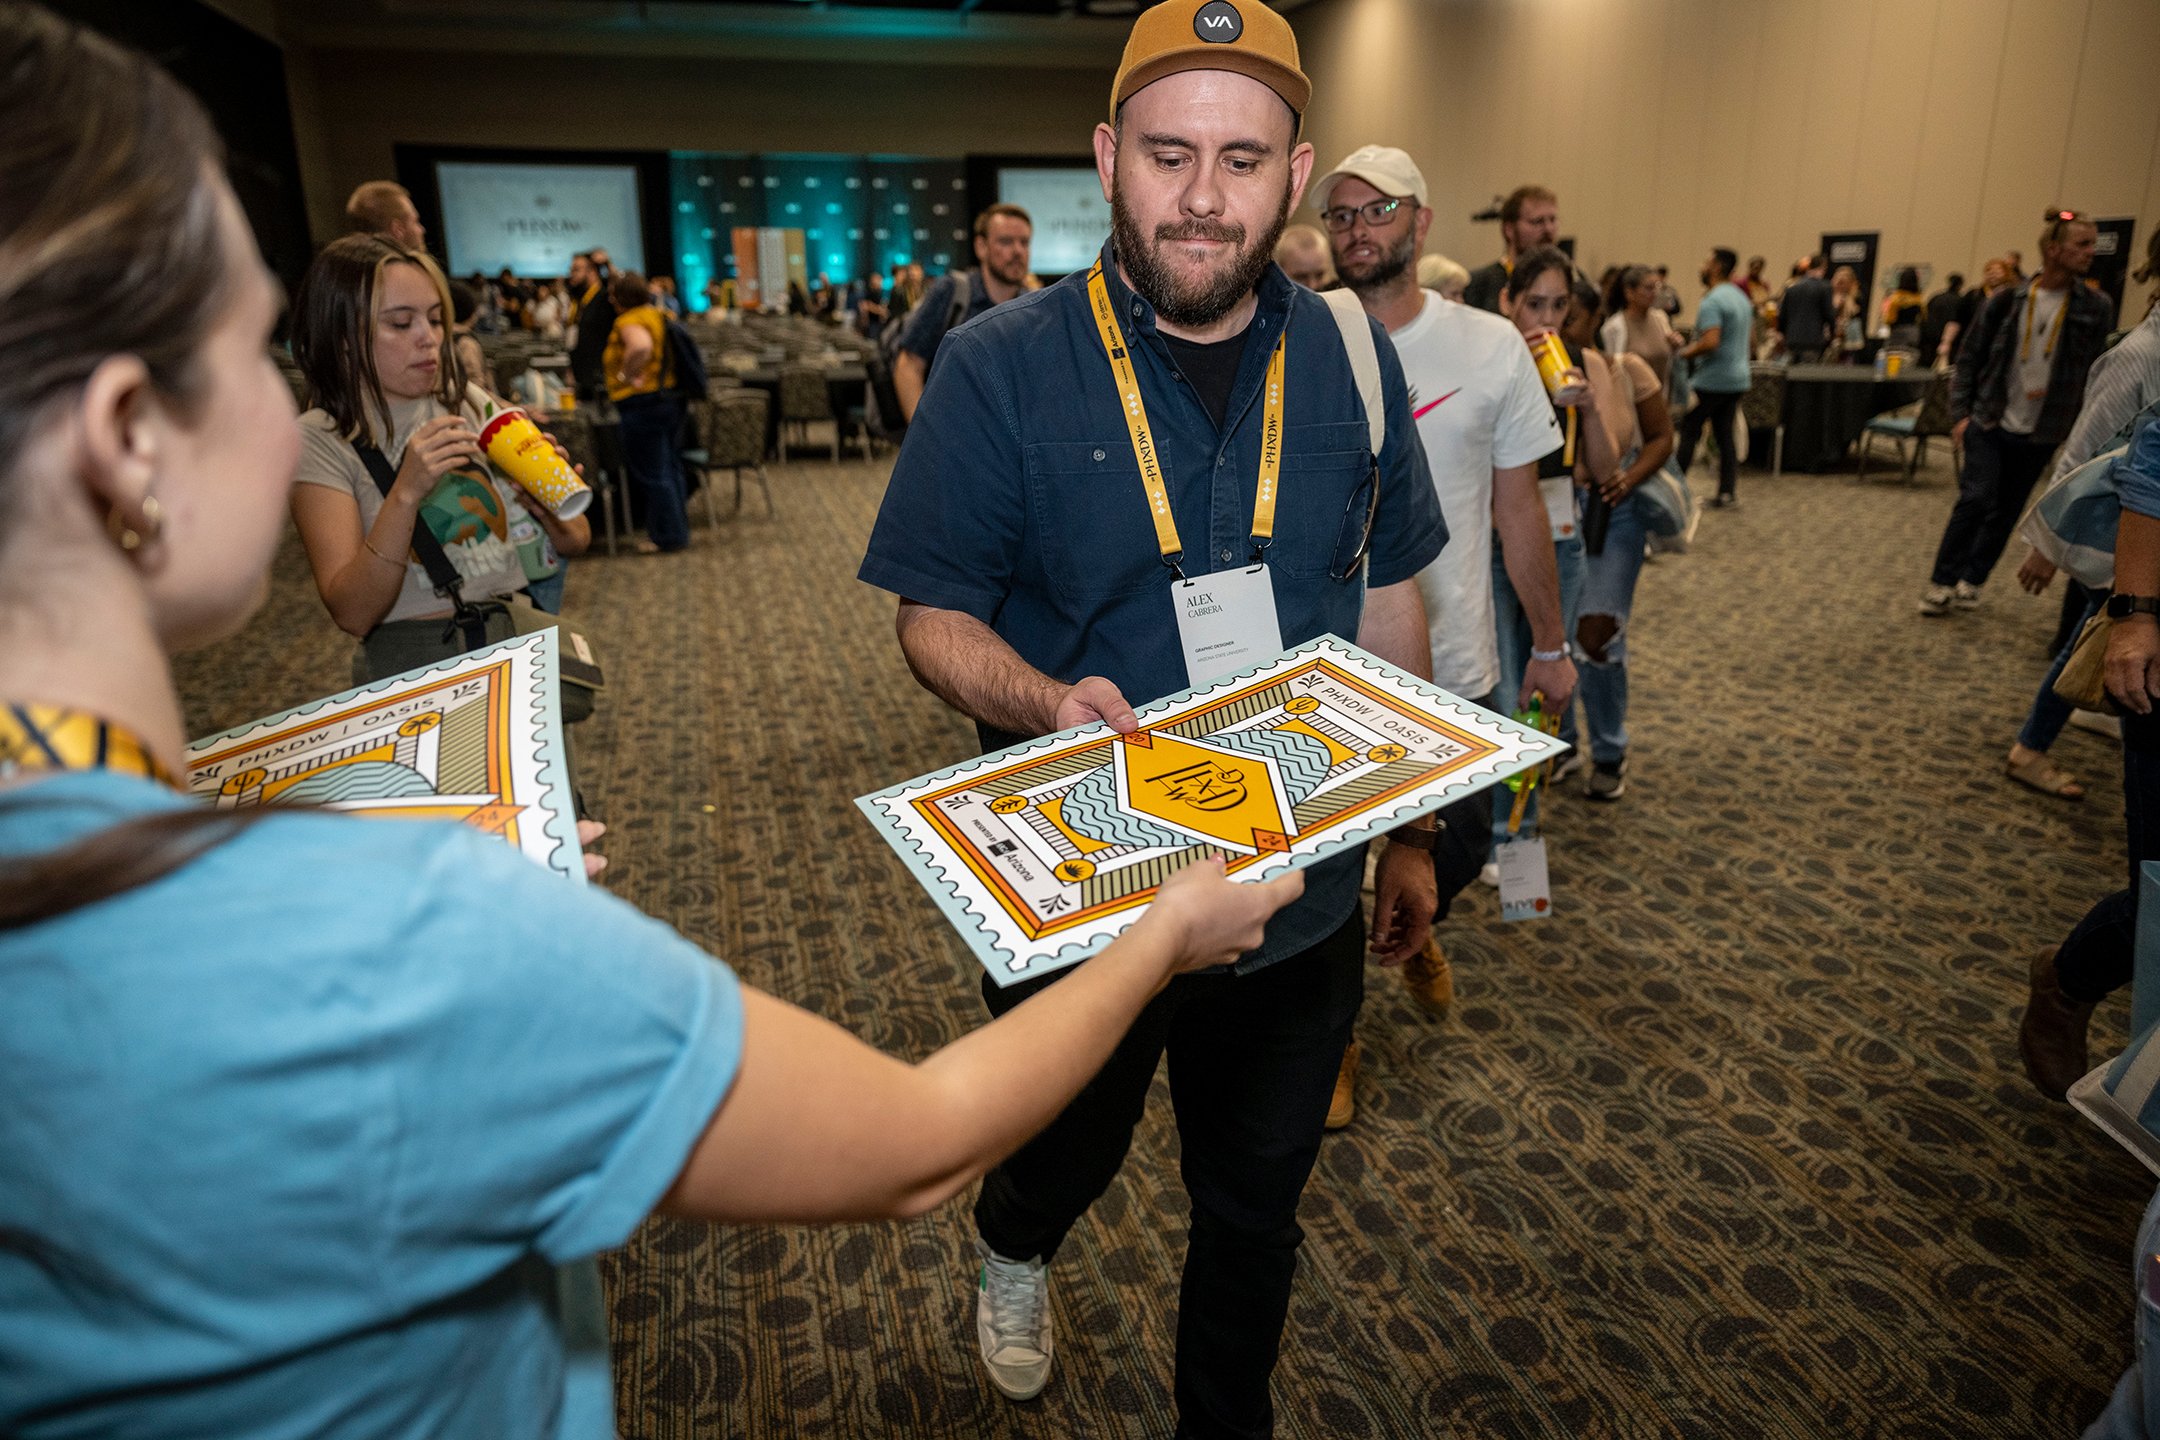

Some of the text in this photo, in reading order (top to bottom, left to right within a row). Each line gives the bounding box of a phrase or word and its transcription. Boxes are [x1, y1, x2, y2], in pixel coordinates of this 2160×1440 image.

[1107, 325, 1119, 347] Arizona
[1186, 592, 1214, 608] ALEX
[1188, 604, 1223, 618] CABRERA
[1195, 640, 1234, 653] GRAPHIC DESIGNER
[1321, 687, 1430, 745] PHXDW OASIS
[238, 697, 435, 768] PHXDW OASIS
[1128, 733, 1145, 742] 20
[1004, 853, 1035, 882] Arizona
